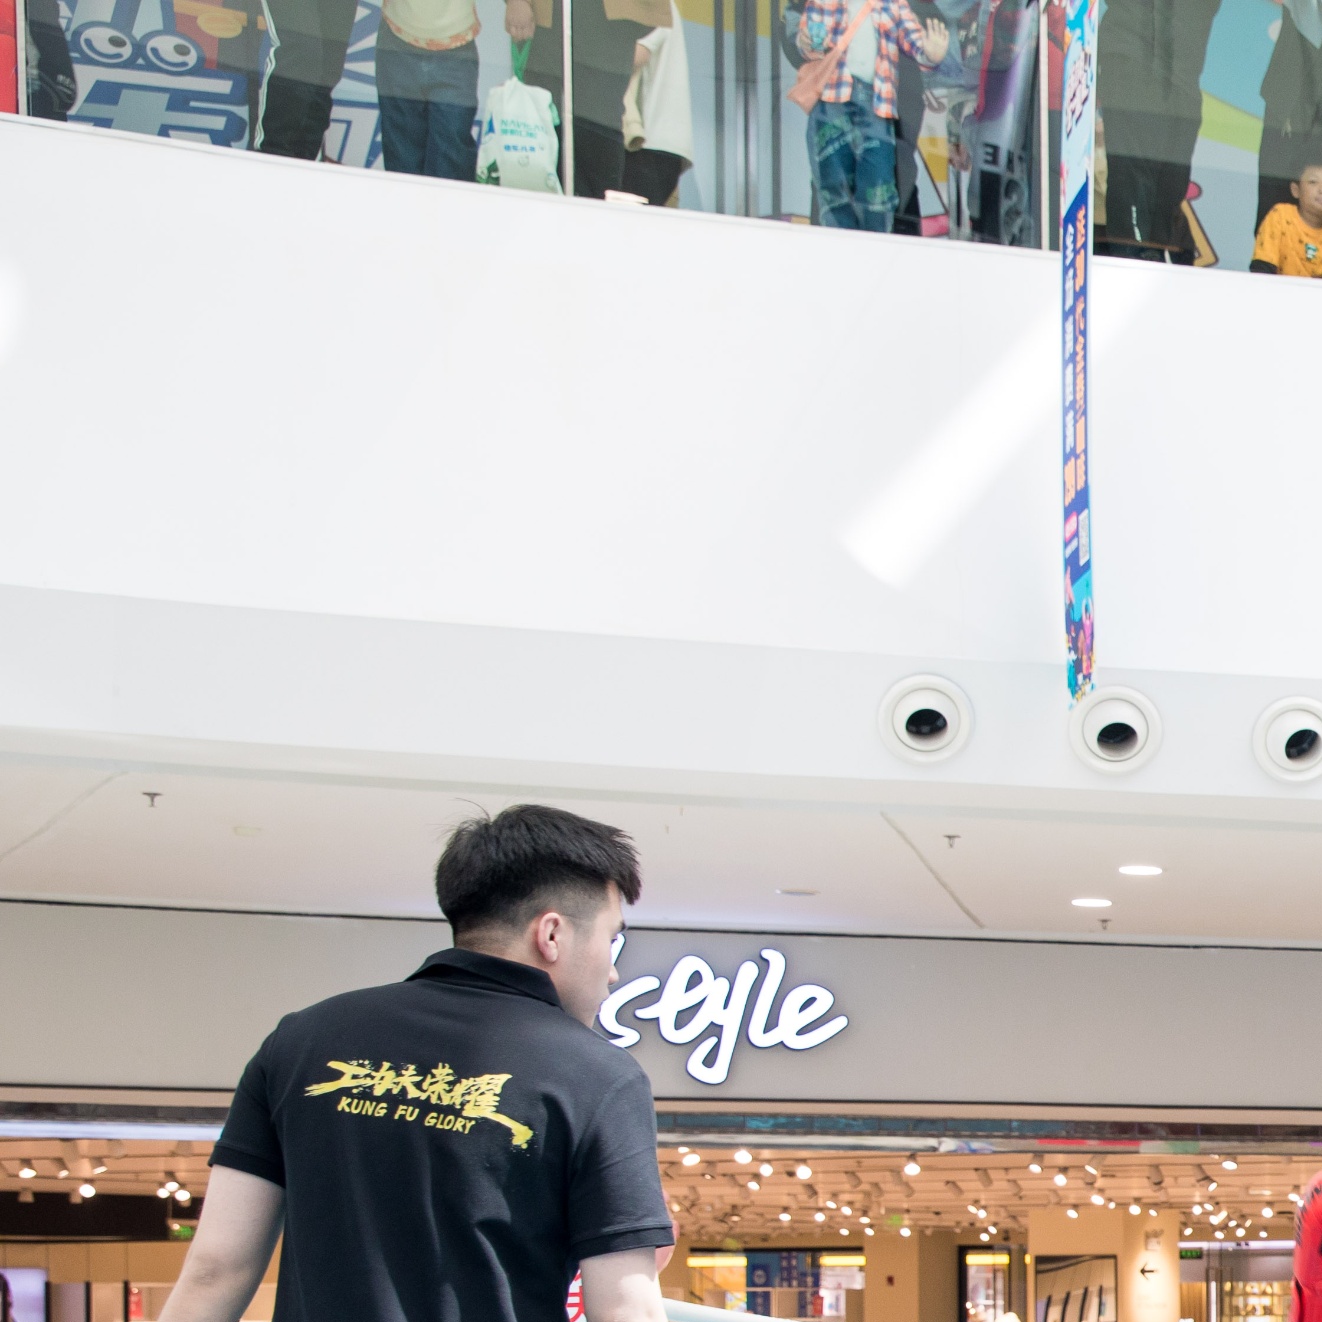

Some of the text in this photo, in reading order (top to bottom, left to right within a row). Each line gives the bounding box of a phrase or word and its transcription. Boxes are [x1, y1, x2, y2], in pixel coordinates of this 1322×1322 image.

[598, 933, 849, 1085] style
[304, 1058, 534, 1149] 功夫荣耀
[337, 1096, 476, 1134] KUNG FU GLORY
